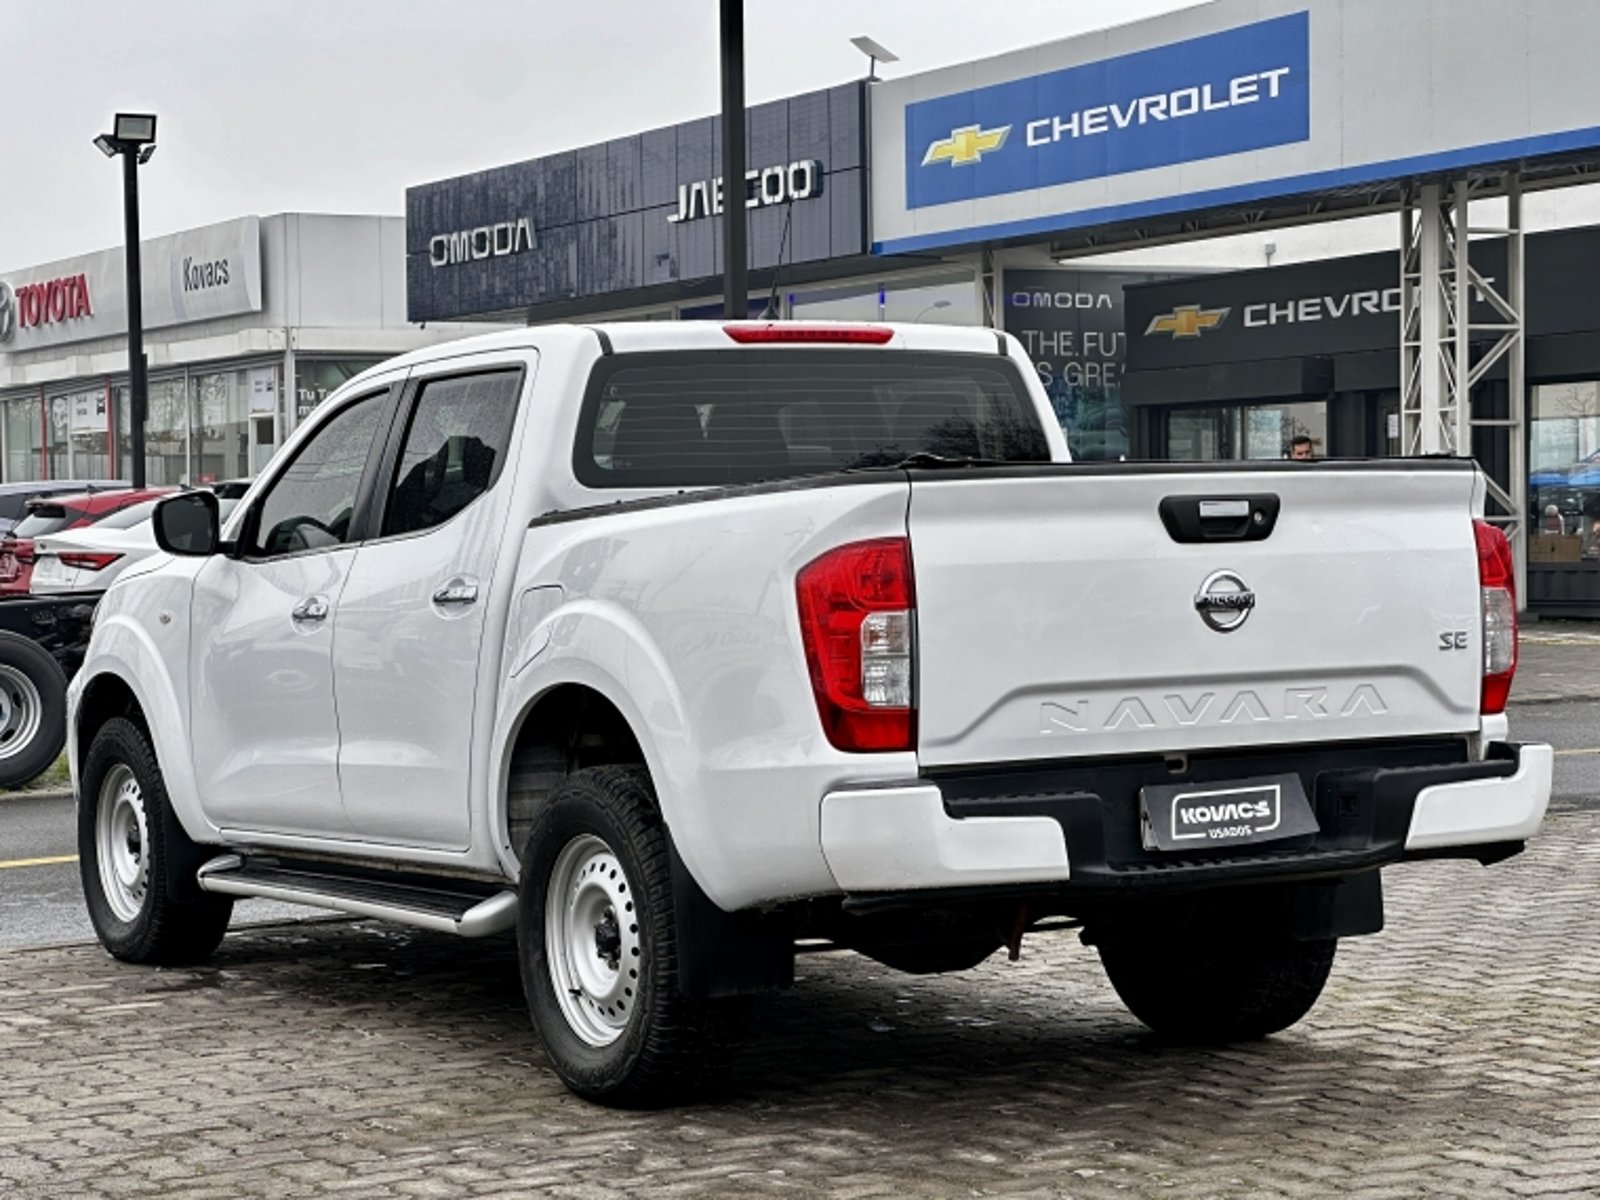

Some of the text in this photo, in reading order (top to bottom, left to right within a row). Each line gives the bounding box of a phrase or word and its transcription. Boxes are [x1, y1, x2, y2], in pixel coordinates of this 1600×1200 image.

[1026, 67, 1291, 147] CHEVROLET
[429, 217, 537, 267] OMODA
[183, 256, 230, 291] Kovacs
[15, 273, 92, 328] TOYOTA
[1012, 292, 1113, 309] OMODA
[1438, 631, 1468, 651] SE
[1040, 683, 1389, 734] NAVARA
[1180, 800, 1271, 824] KOVACS
[1208, 824, 1252, 839] USADOS
